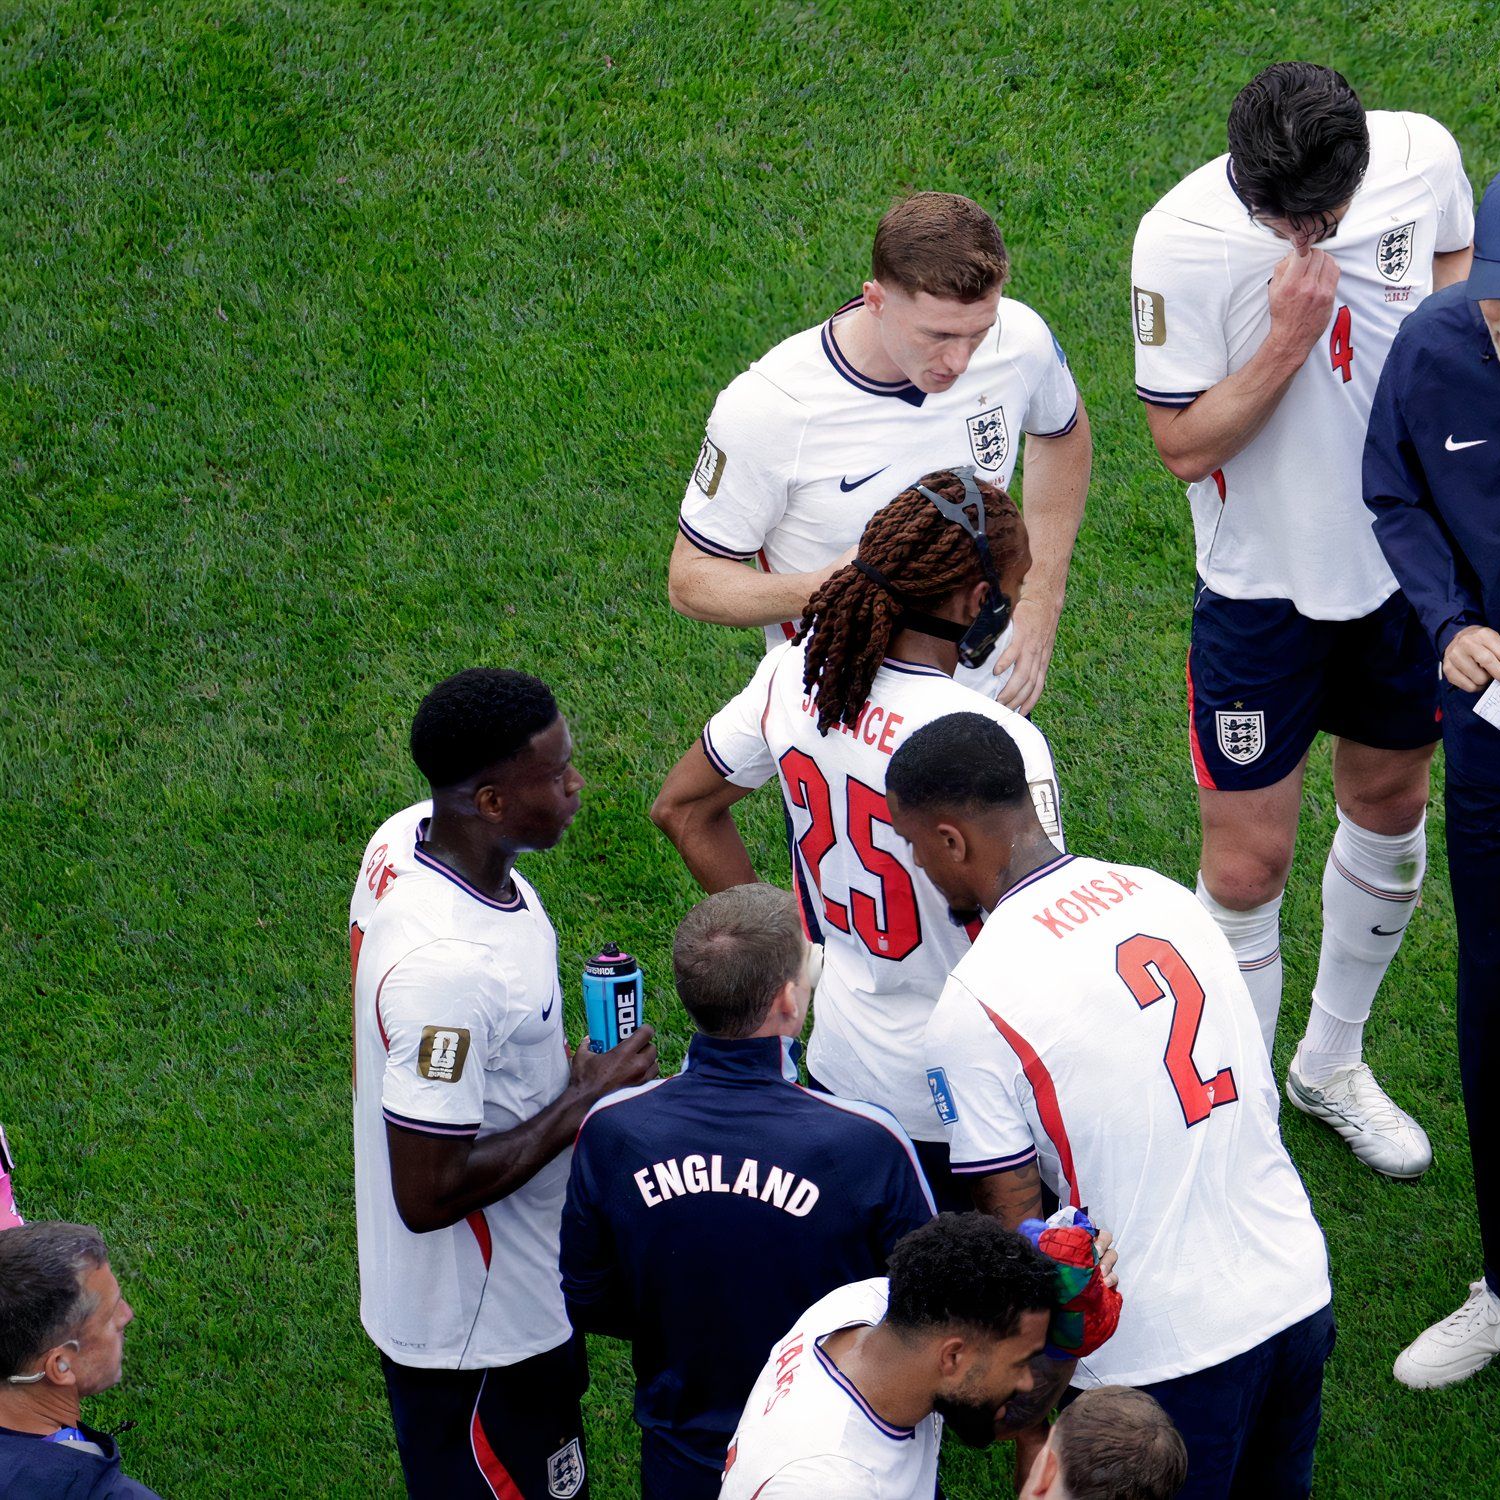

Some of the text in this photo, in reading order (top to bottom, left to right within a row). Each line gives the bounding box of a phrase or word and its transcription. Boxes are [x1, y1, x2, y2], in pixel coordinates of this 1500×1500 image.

[1329, 305, 1354, 384] 4
[779, 745, 923, 962] 25
[1032, 871, 1144, 939] KONSA
[1115, 932, 1239, 1129] 2
[633, 1154, 821, 1218] ENGLAND
